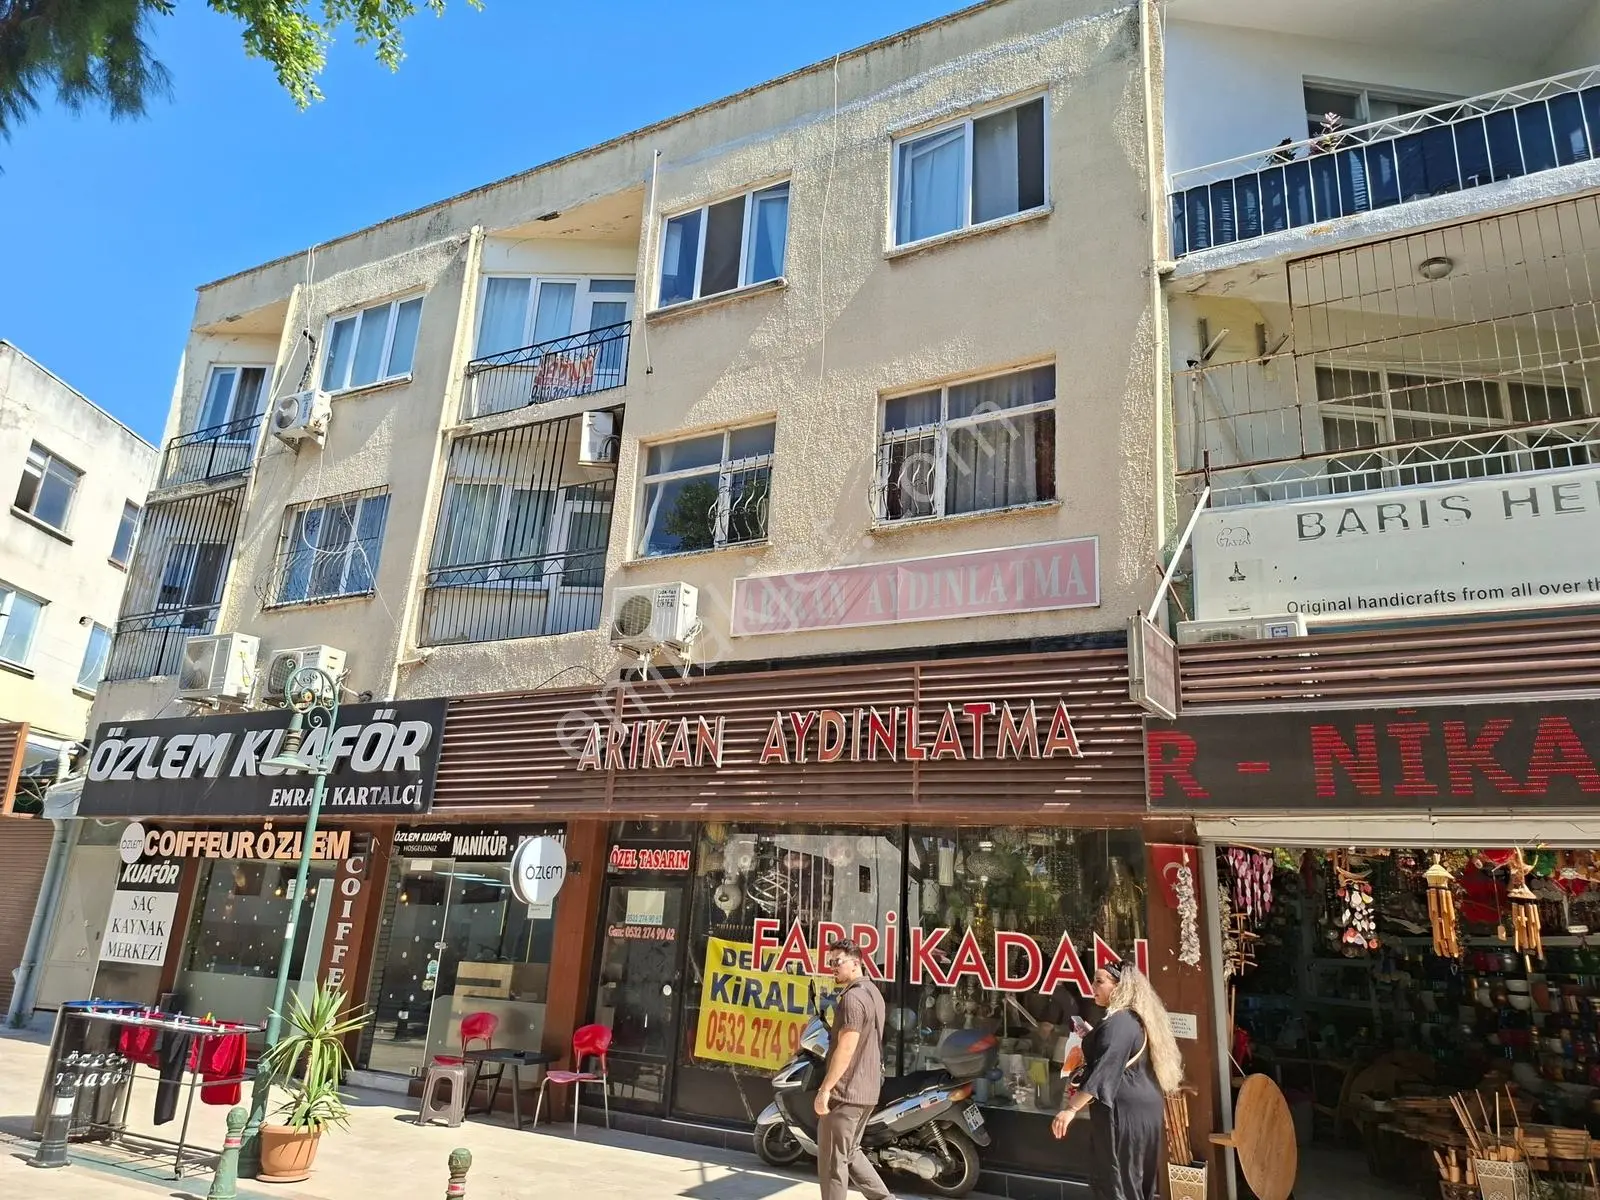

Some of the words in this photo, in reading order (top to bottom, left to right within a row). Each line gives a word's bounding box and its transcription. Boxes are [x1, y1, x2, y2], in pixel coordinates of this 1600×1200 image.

[1297, 495, 1472, 541] BARIS
[1502, 480, 1600, 520] HE
[866, 553, 1088, 615] AYDINLATMA
[1287, 596, 1352, 616] Original
[1357, 588, 1456, 609] handicrafts
[1462, 587, 1504, 601] from
[1511, 583, 1532, 597] all
[1539, 582, 1581, 596] over
[88, 727, 238, 781] ÖZLEM
[230, 708, 433, 777] KUAFÖR
[576, 715, 725, 771] ARIKAN
[758, 697, 1084, 764] AYDINLATMA
[331, 778, 424, 806] KARTALCİ
[144, 829, 254, 859] COIFFEUR
[256, 821, 351, 860] ÖZLEM
[394, 830, 420, 842] ÖZLEM
[420, 830, 452, 842] KUAFÖR
[451, 830, 508, 857] MANİKÜR
[609, 844, 638, 869] ÖZEL
[638, 848, 691, 871] TASARIM
[122, 860, 180, 885] KUAFÖR
[525, 864, 563, 880] ÖZLEM
[131, 895, 156, 914] SAÇ
[110, 918, 166, 938] KAYNAK
[642, 927, 656, 940] 274
[656, 927, 666, 940] 90
[106, 941, 163, 961] MERKEZİ
[705, 1008, 746, 1055] 0532
[750, 1016, 784, 1061] 274
